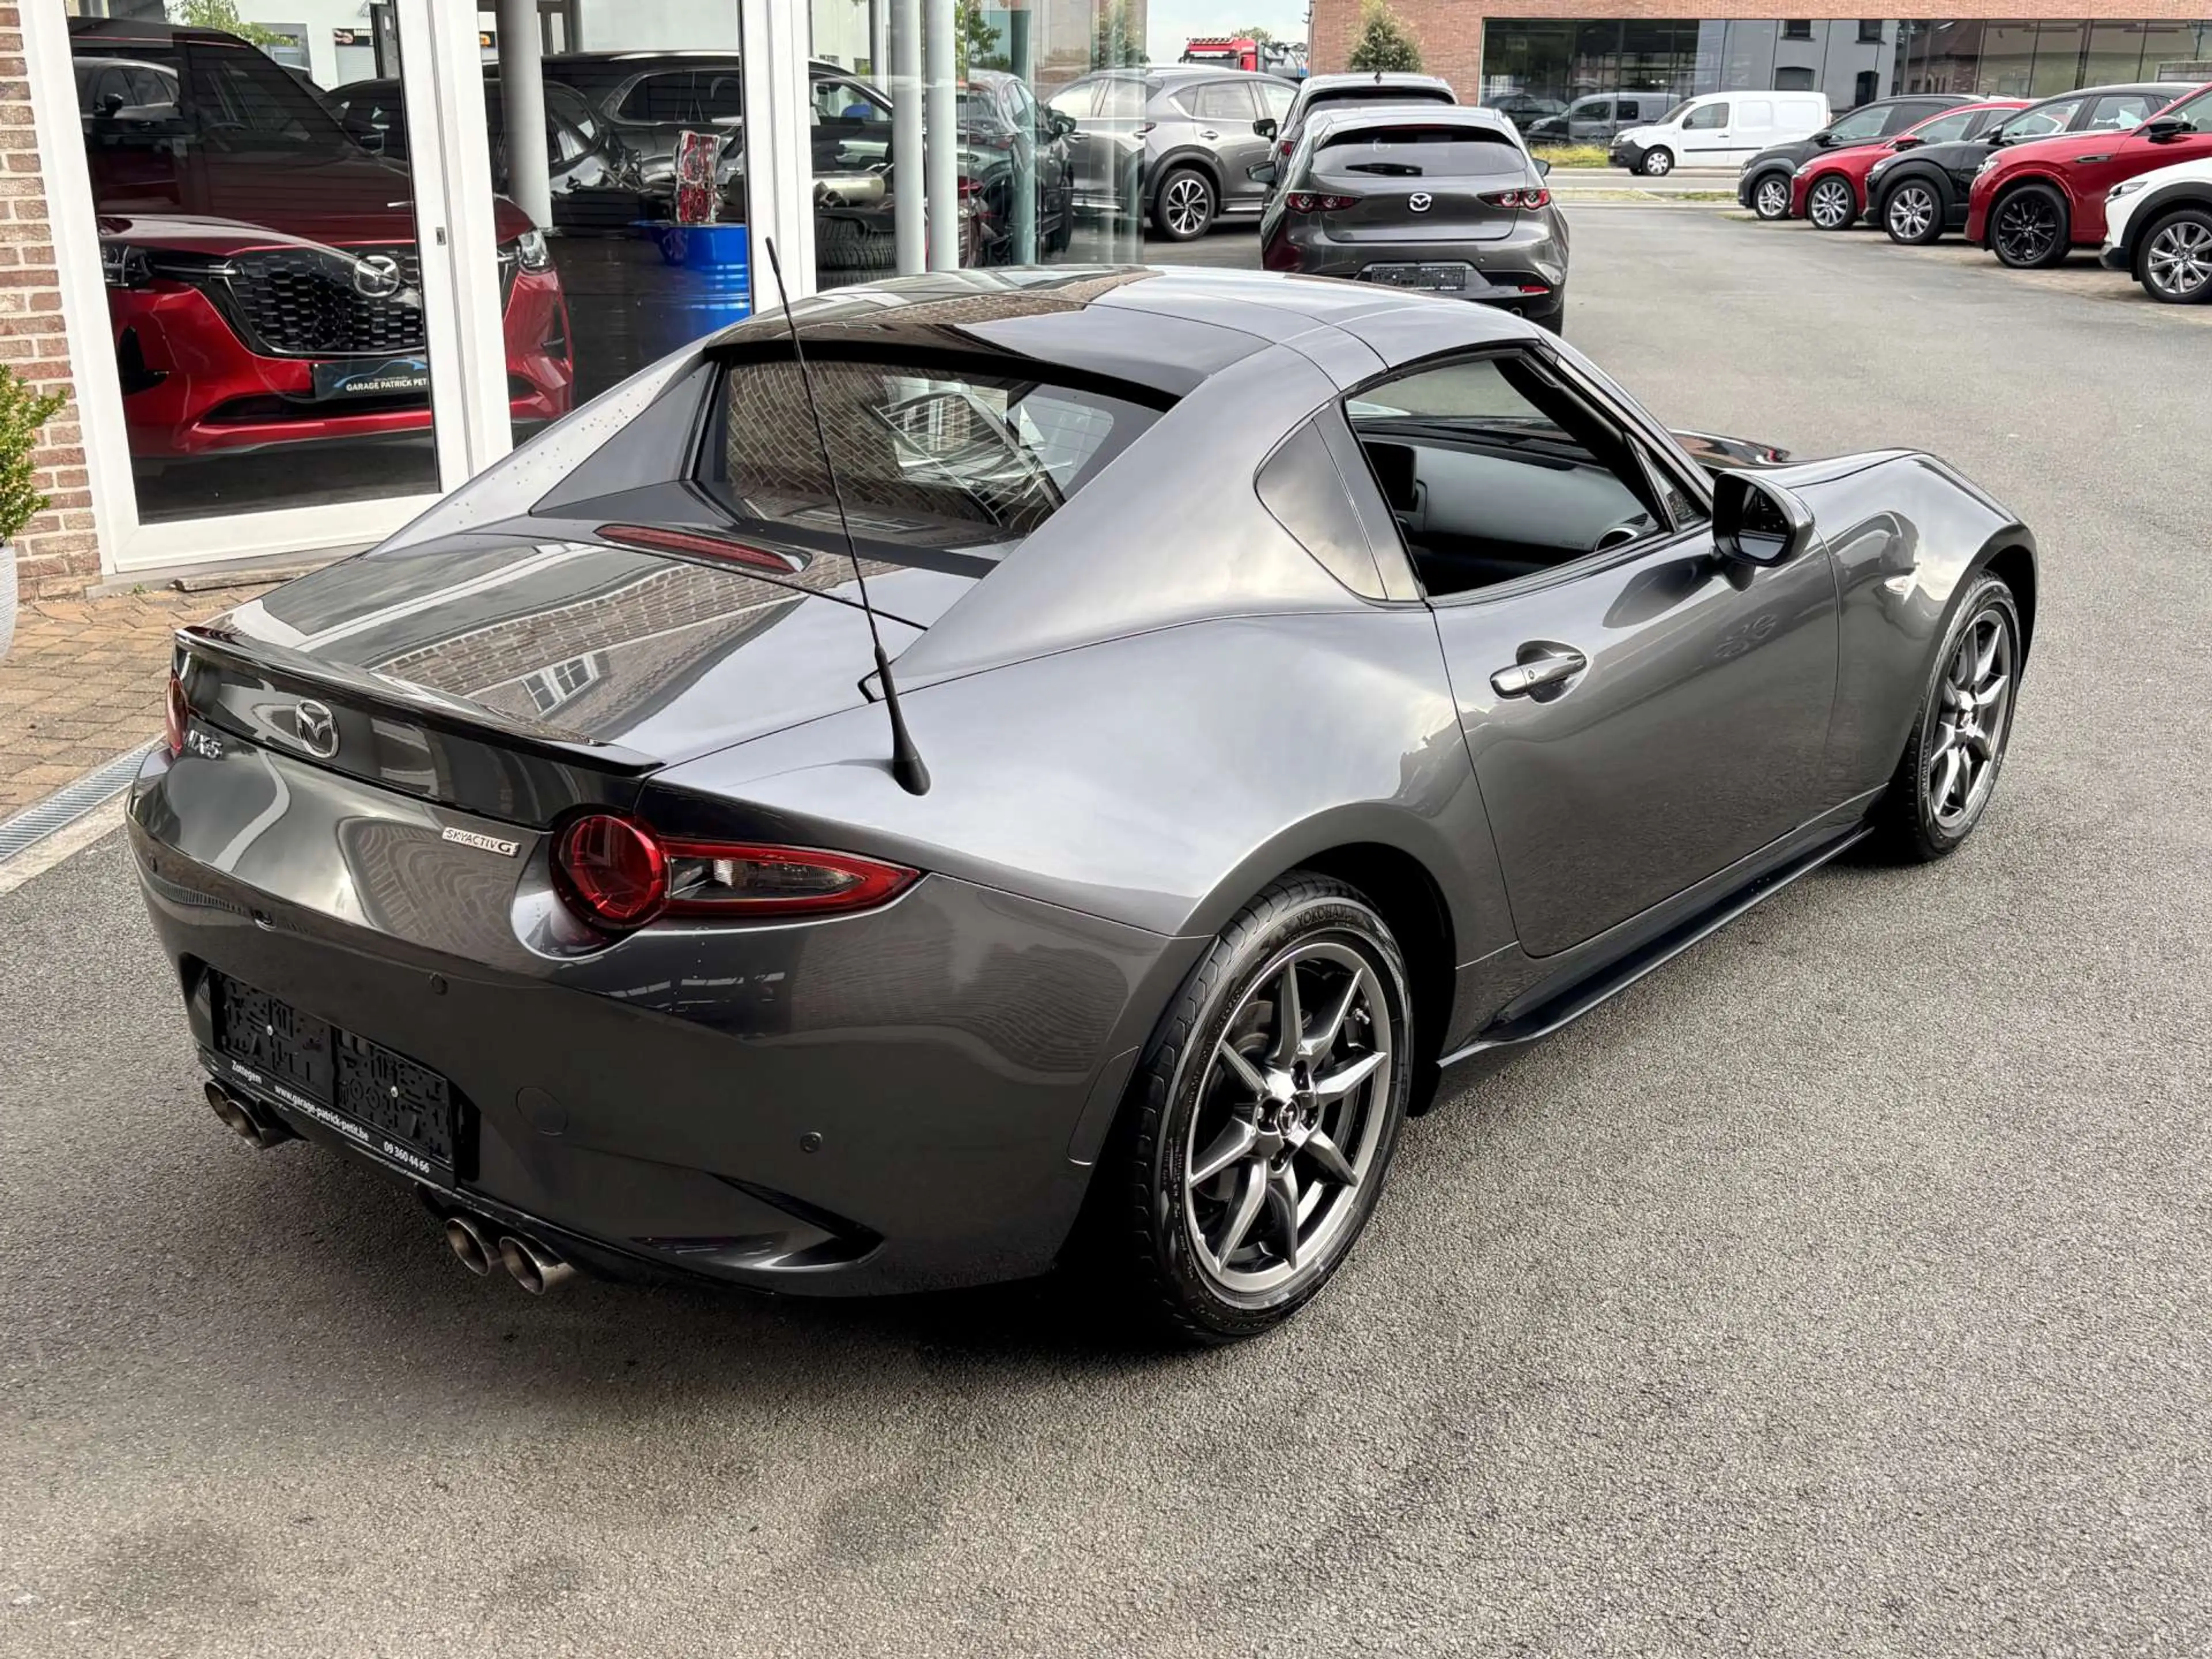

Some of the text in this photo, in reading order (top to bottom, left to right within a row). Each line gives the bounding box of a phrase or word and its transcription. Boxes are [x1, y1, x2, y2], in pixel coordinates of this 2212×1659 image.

[346, 381, 380, 392] GARAGE
[381, 378, 412, 389] PATRICK
[447, 830, 497, 849] SKYACTIV
[232, 1060, 263, 1085] Zottegem
[383, 1141, 393, 1154] 09
[409, 1155, 419, 1168] 44
